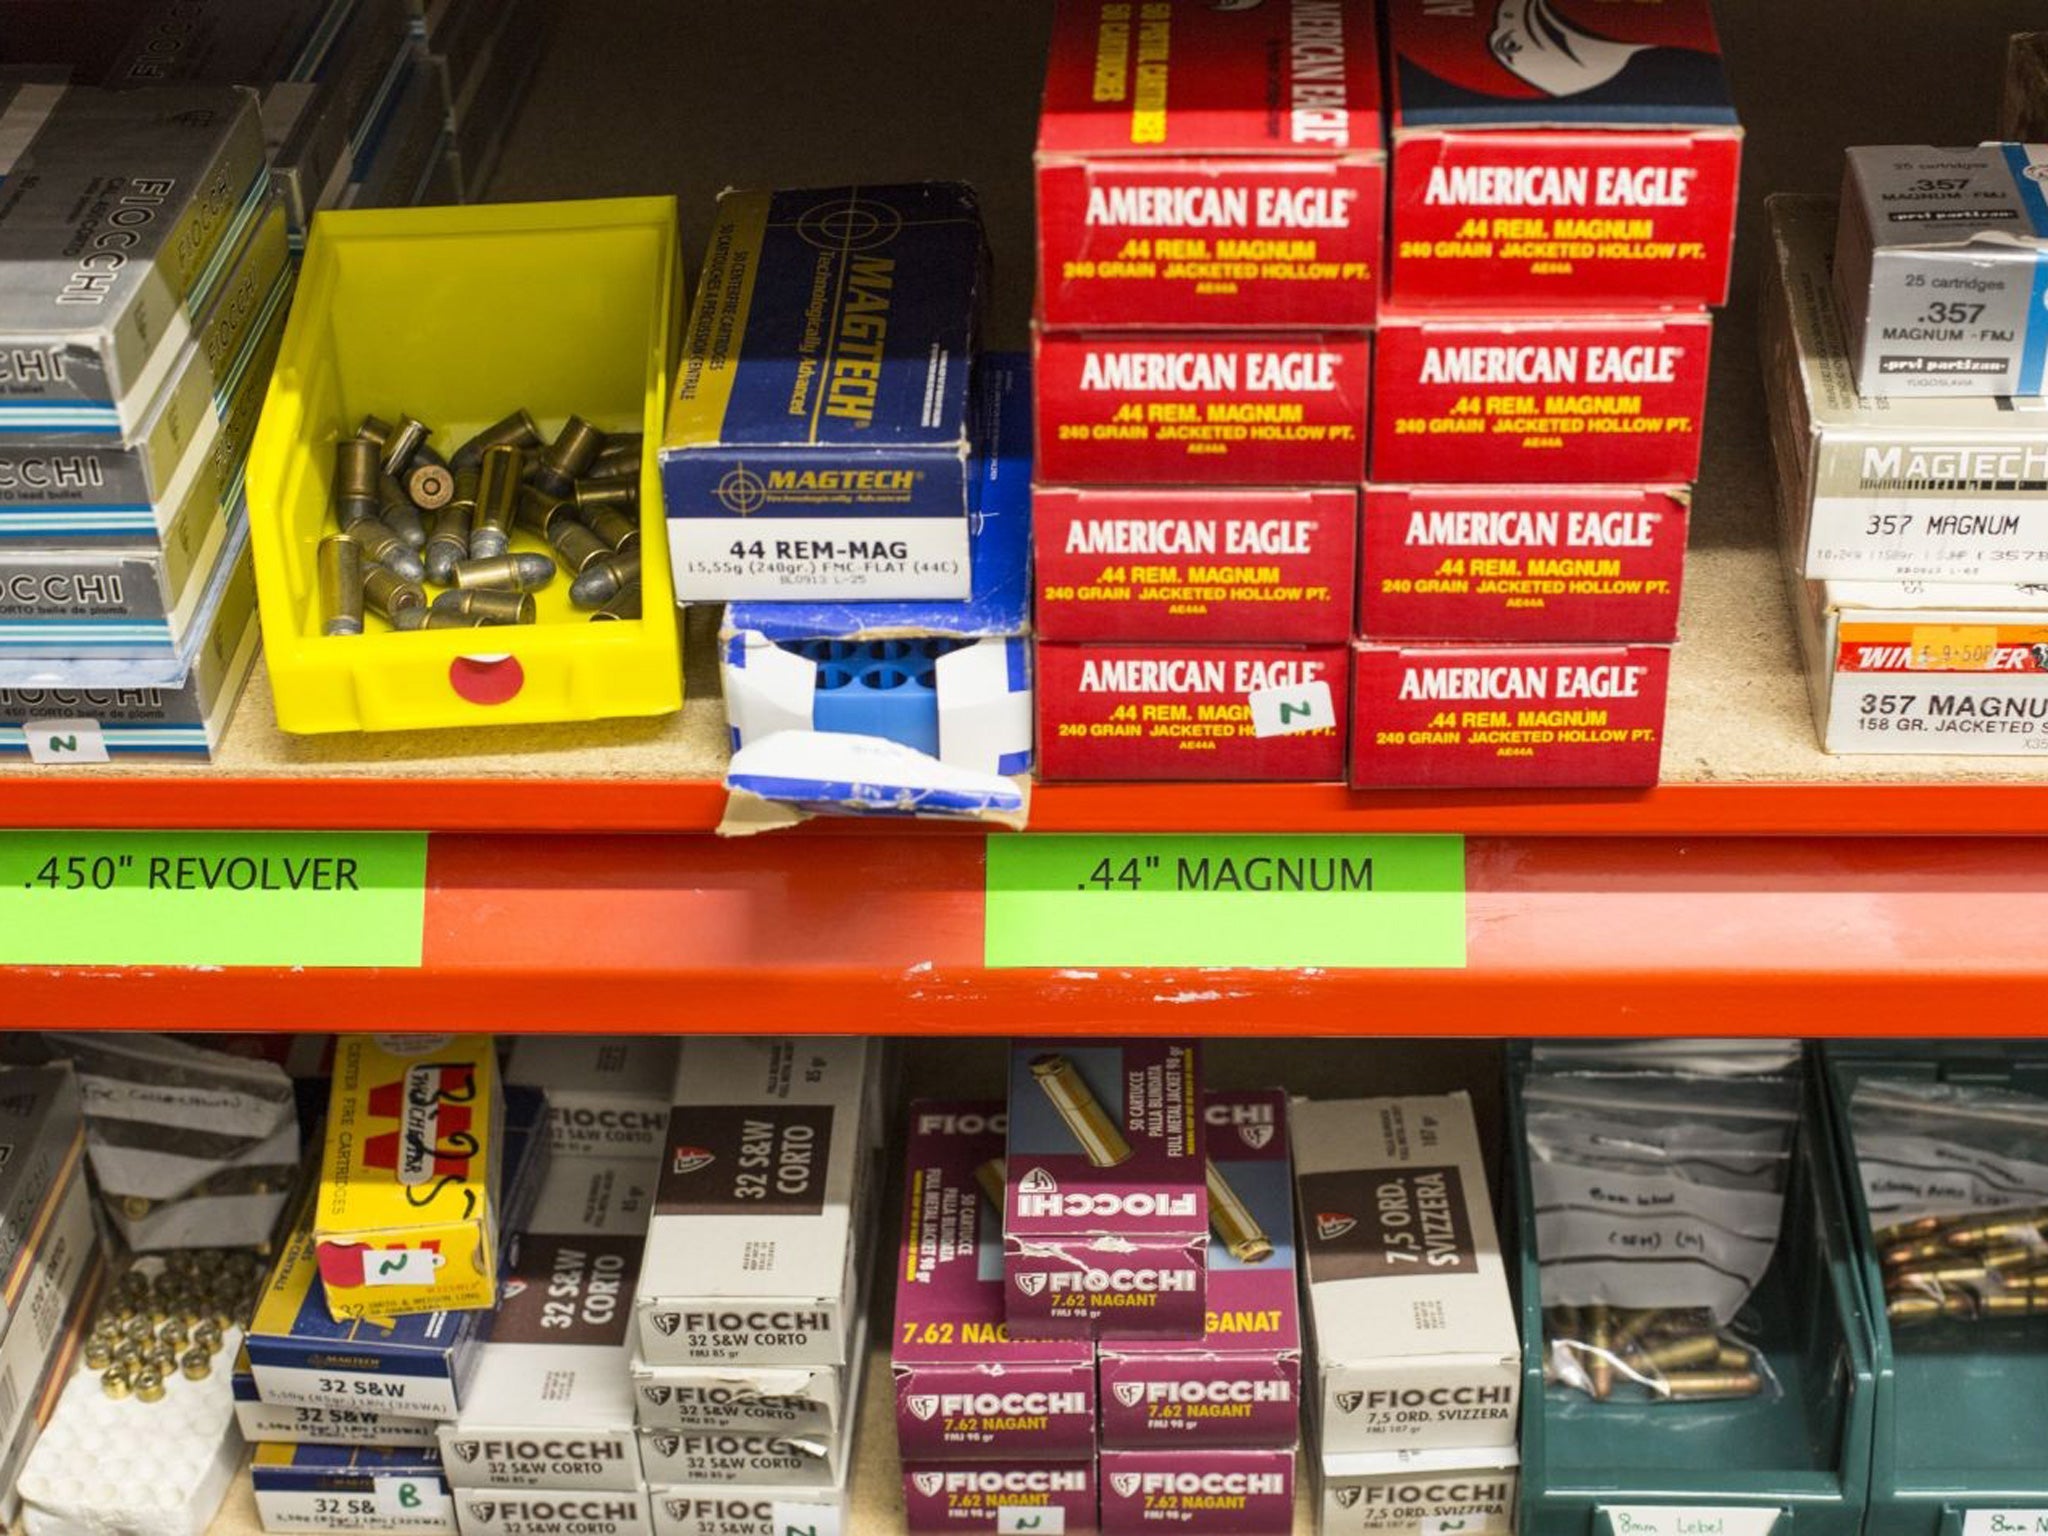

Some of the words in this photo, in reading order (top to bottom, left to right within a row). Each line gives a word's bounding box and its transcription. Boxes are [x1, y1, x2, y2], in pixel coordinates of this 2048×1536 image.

[1291, 84, 1348, 147] EAGLE
[1425, 167, 1588, 206] AMERICAN
[1595, 167, 1688, 206] EAGLE
[1908, 179, 1970, 191] .357
[1085, 187, 1247, 227] AMERICAN
[1256, 187, 1350, 228] EAGLE
[1455, 219, 1487, 238] .44
[1493, 219, 1549, 238] REM.
[1553, 219, 1653, 239] MAGNUM
[55, 178, 175, 305] FIOCCHI
[1118, 240, 1150, 259] .44
[1156, 240, 1211, 259] REM.
[1216, 240, 1316, 260] MAGNUM
[1906, 275, 1925, 287] 25
[1931, 276, 2004, 291] cartridges
[1917, 303, 1986, 323] .357
[826, 255, 896, 421] MAGTECH
[1883, 328, 1963, 341] MAGNUM
[1080, 353, 1237, 391] AMERICAN
[1246, 353, 1335, 391] EAGLE
[1419, 347, 1578, 384] AMERICAN
[1586, 346, 1675, 383] EAGLE
[767, 470, 914, 490] MAGTECH
[1405, 511, 1558, 546] AMERICAN
[1566, 512, 1653, 546] EAGLE
[1866, 516, 1912, 534] 357
[1926, 516, 2020, 534] MAGNUM
[1065, 519, 1216, 554] AMERICAN
[1225, 519, 1311, 554] EAGLE
[730, 542, 765, 559] 44
[777, 542, 908, 559] REM-MAG
[914, 561, 959, 574] (44C)
[1096, 566, 1126, 584] .44
[1130, 566, 1183, 584] REM.
[1188, 566, 1280, 584] MAGNUM
[1434, 559, 1465, 577] .44
[1470, 559, 1522, 577] REM.
[1527, 559, 1621, 577] MAGNUM
[1079, 660, 1225, 693] AMERICAN
[1234, 661, 1318, 693] EAGLE
[1399, 666, 1548, 700] AMERICAN
[1556, 665, 1640, 698] EAGLE
[30, 707, 73, 718] CORTO
[1861, 694, 1916, 715] 357
[1428, 712, 1457, 728] .44
[1462, 711, 1512, 728] REM.
[1517, 710, 1608, 727] MAGNUM
[1859, 717, 1889, 730] 158
[1897, 719, 1927, 731] GR.
[1936, 720, 2034, 733] JACKETED
[1376, 731, 1405, 744] 240
[1408, 731, 1460, 744] GRAIN
[1468, 730, 1554, 743] JACKETED
[1557, 730, 1628, 742] HOLLOW
[1631, 729, 1655, 742] PT.
[24, 855, 133, 890] .450"
[148, 856, 359, 891] REVOLVER
[1077, 856, 1160, 891] .44"
[1177, 857, 1373, 892] MAGNUM
[1130, 1071, 1144, 1117] CARTUCCE
[1166, 1072, 1181, 1103] JACKET
[344, 1098, 357, 1125] FIRE
[1167, 1105, 1182, 1133] METAL
[1148, 1110, 1162, 1136] PALLA
[739, 1120, 775, 1168] S&W
[1168, 1135, 1182, 1156] FULL
[777, 1125, 814, 1194] CORTO
[332, 1128, 352, 1214] CARTRIDGES
[734, 1174, 768, 1199] 32
[1018, 1193, 1196, 1217] FIOCCHI
[1377, 1178, 1411, 1226] ORD.
[1414, 1172, 1460, 1266] SVIZZERA
[1384, 1233, 1421, 1264] 7,5
[549, 1249, 586, 1298] S&W
[1050, 1269, 1196, 1291] FIOCCHI
[582, 1255, 624, 1325] CORTO
[1052, 1294, 1085, 1306] 7.62
[1090, 1294, 1157, 1306] NAGANT
[540, 1301, 576, 1329] 32
[685, 1312, 829, 1331] FIOCCHI
[1206, 1311, 1282, 1332] GANAT
[689, 1335, 707, 1346] 32
[713, 1335, 748, 1346] S&W
[754, 1334, 807, 1346] CORTO
[902, 1323, 954, 1343] 7.62
[319, 1379, 347, 1393] 32
[355, 1381, 404, 1397] S&W
[1147, 1381, 1290, 1402] FIOCCHI
[1367, 1386, 1512, 1408] FIOCCHI
[941, 1392, 1085, 1416] FIOCCHI
[1148, 1405, 1182, 1417] 7.62
[1187, 1404, 1253, 1417] NAGANT
[297, 1408, 323, 1422] 32
[330, 1409, 378, 1424] S&W
[944, 1419, 977, 1430] 7.62
[983, 1417, 1048, 1430] NAGANT
[1368, 1412, 1390, 1423] 7,5
[1396, 1411, 1431, 1422] ORD.
[1438, 1409, 1508, 1421] SVIZZERA
[484, 1441, 624, 1460] FIOCCHI
[488, 1463, 505, 1473] 32
[511, 1463, 545, 1473] S&W
[552, 1462, 602, 1474] CORTO
[946, 1471, 1086, 1492] FIOCCHI
[1143, 1473, 1284, 1494] FIOCCHI
[399, 1483, 421, 1508] B
[1365, 1485, 1507, 1504] FIOCCHI
[501, 1502, 637, 1521] FIOCCHI
[505, 1523, 520, 1533] 32
[527, 1523, 560, 1533] S&W
[566, 1522, 616, 1534] CORTO
[1677, 1517, 1723, 1534] Lebel
